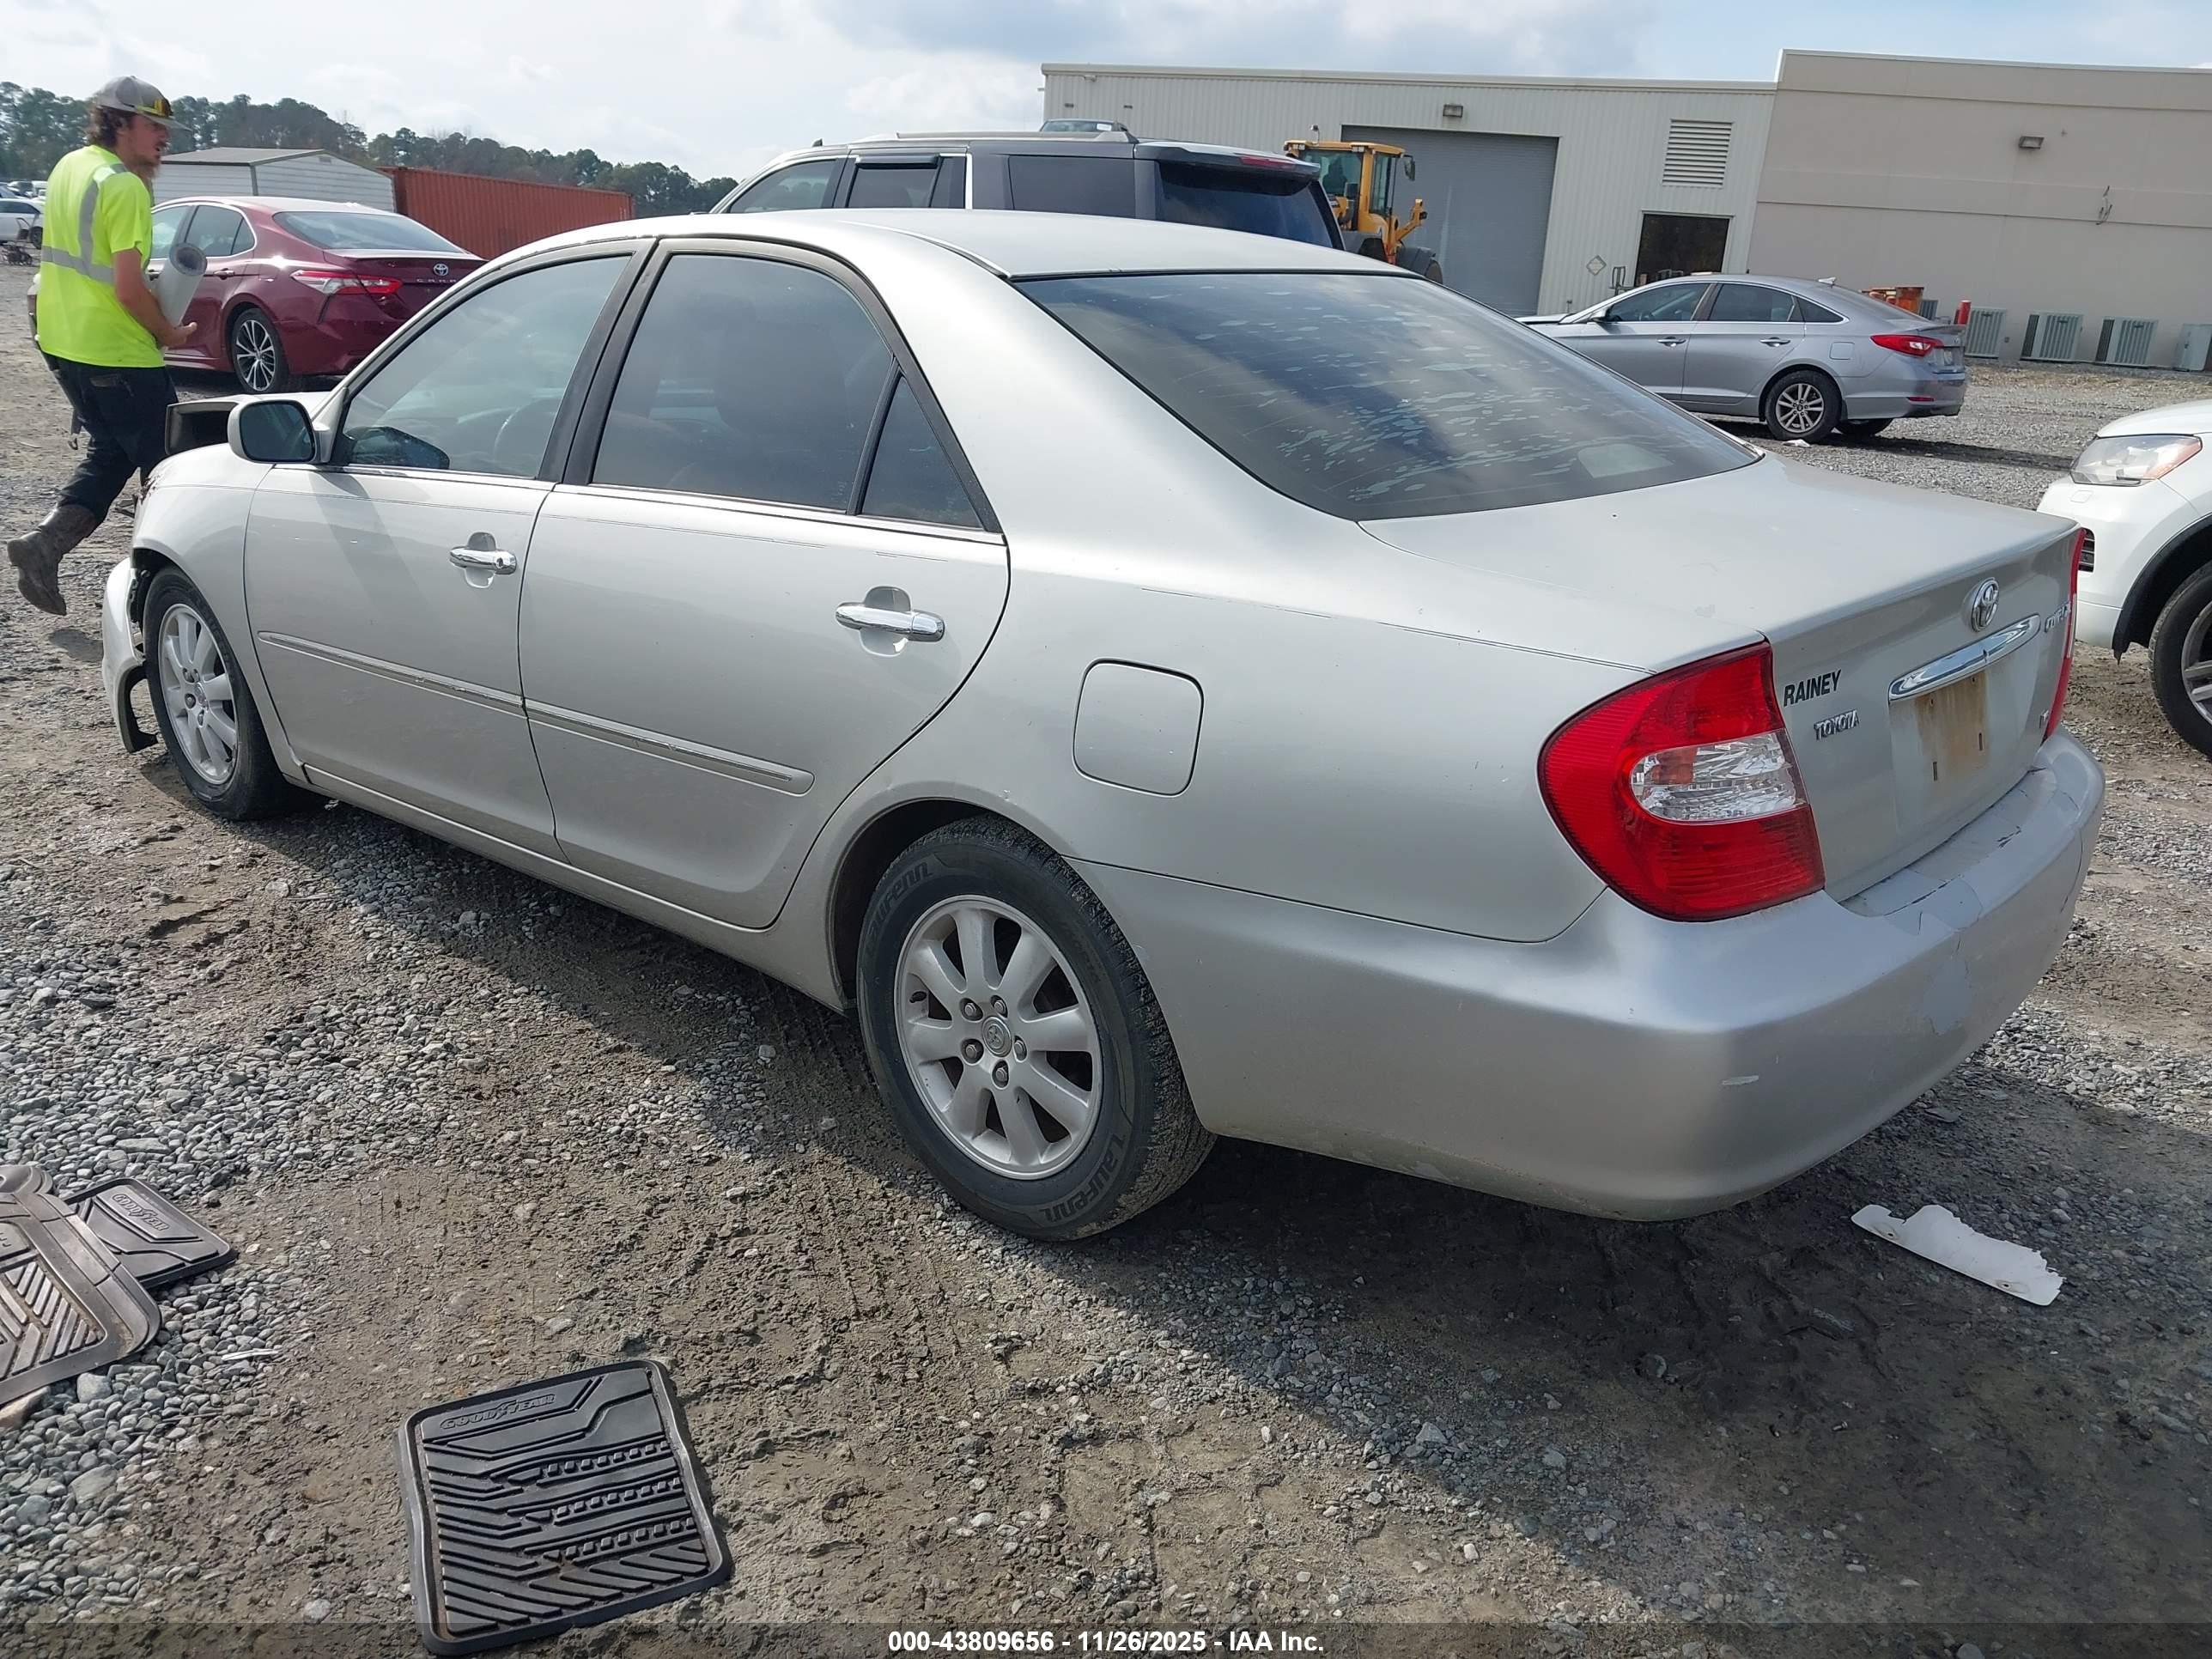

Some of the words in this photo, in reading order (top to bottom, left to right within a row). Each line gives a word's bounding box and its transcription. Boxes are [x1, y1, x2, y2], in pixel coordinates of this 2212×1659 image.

[1784, 669, 1842, 708] RAINEY
[1814, 710, 1859, 740] TOYOTA
[112, 1193, 171, 1231] GOODYEAR
[439, 1393, 556, 1430] GOODYEAR
